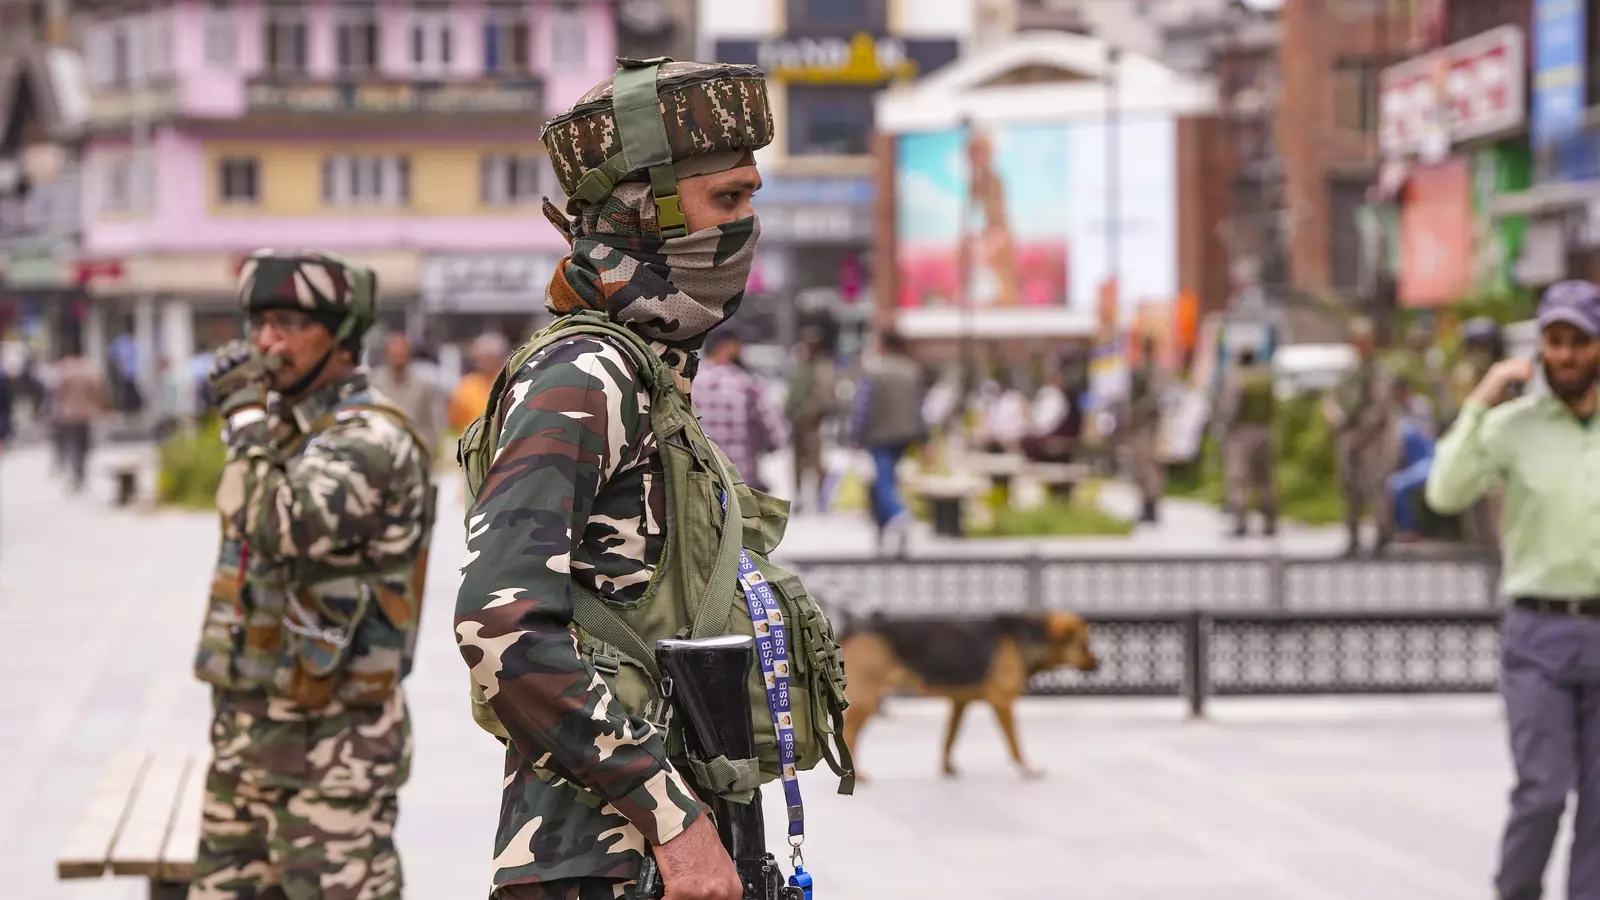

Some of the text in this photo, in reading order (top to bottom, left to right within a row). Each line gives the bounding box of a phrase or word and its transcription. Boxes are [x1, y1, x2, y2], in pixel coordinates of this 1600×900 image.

[757, 586, 775, 605] SSB
[762, 640, 773, 666] SSB
[775, 629, 785, 655] SSB
[779, 681, 789, 707] SSB
[784, 733, 794, 758] SSB
